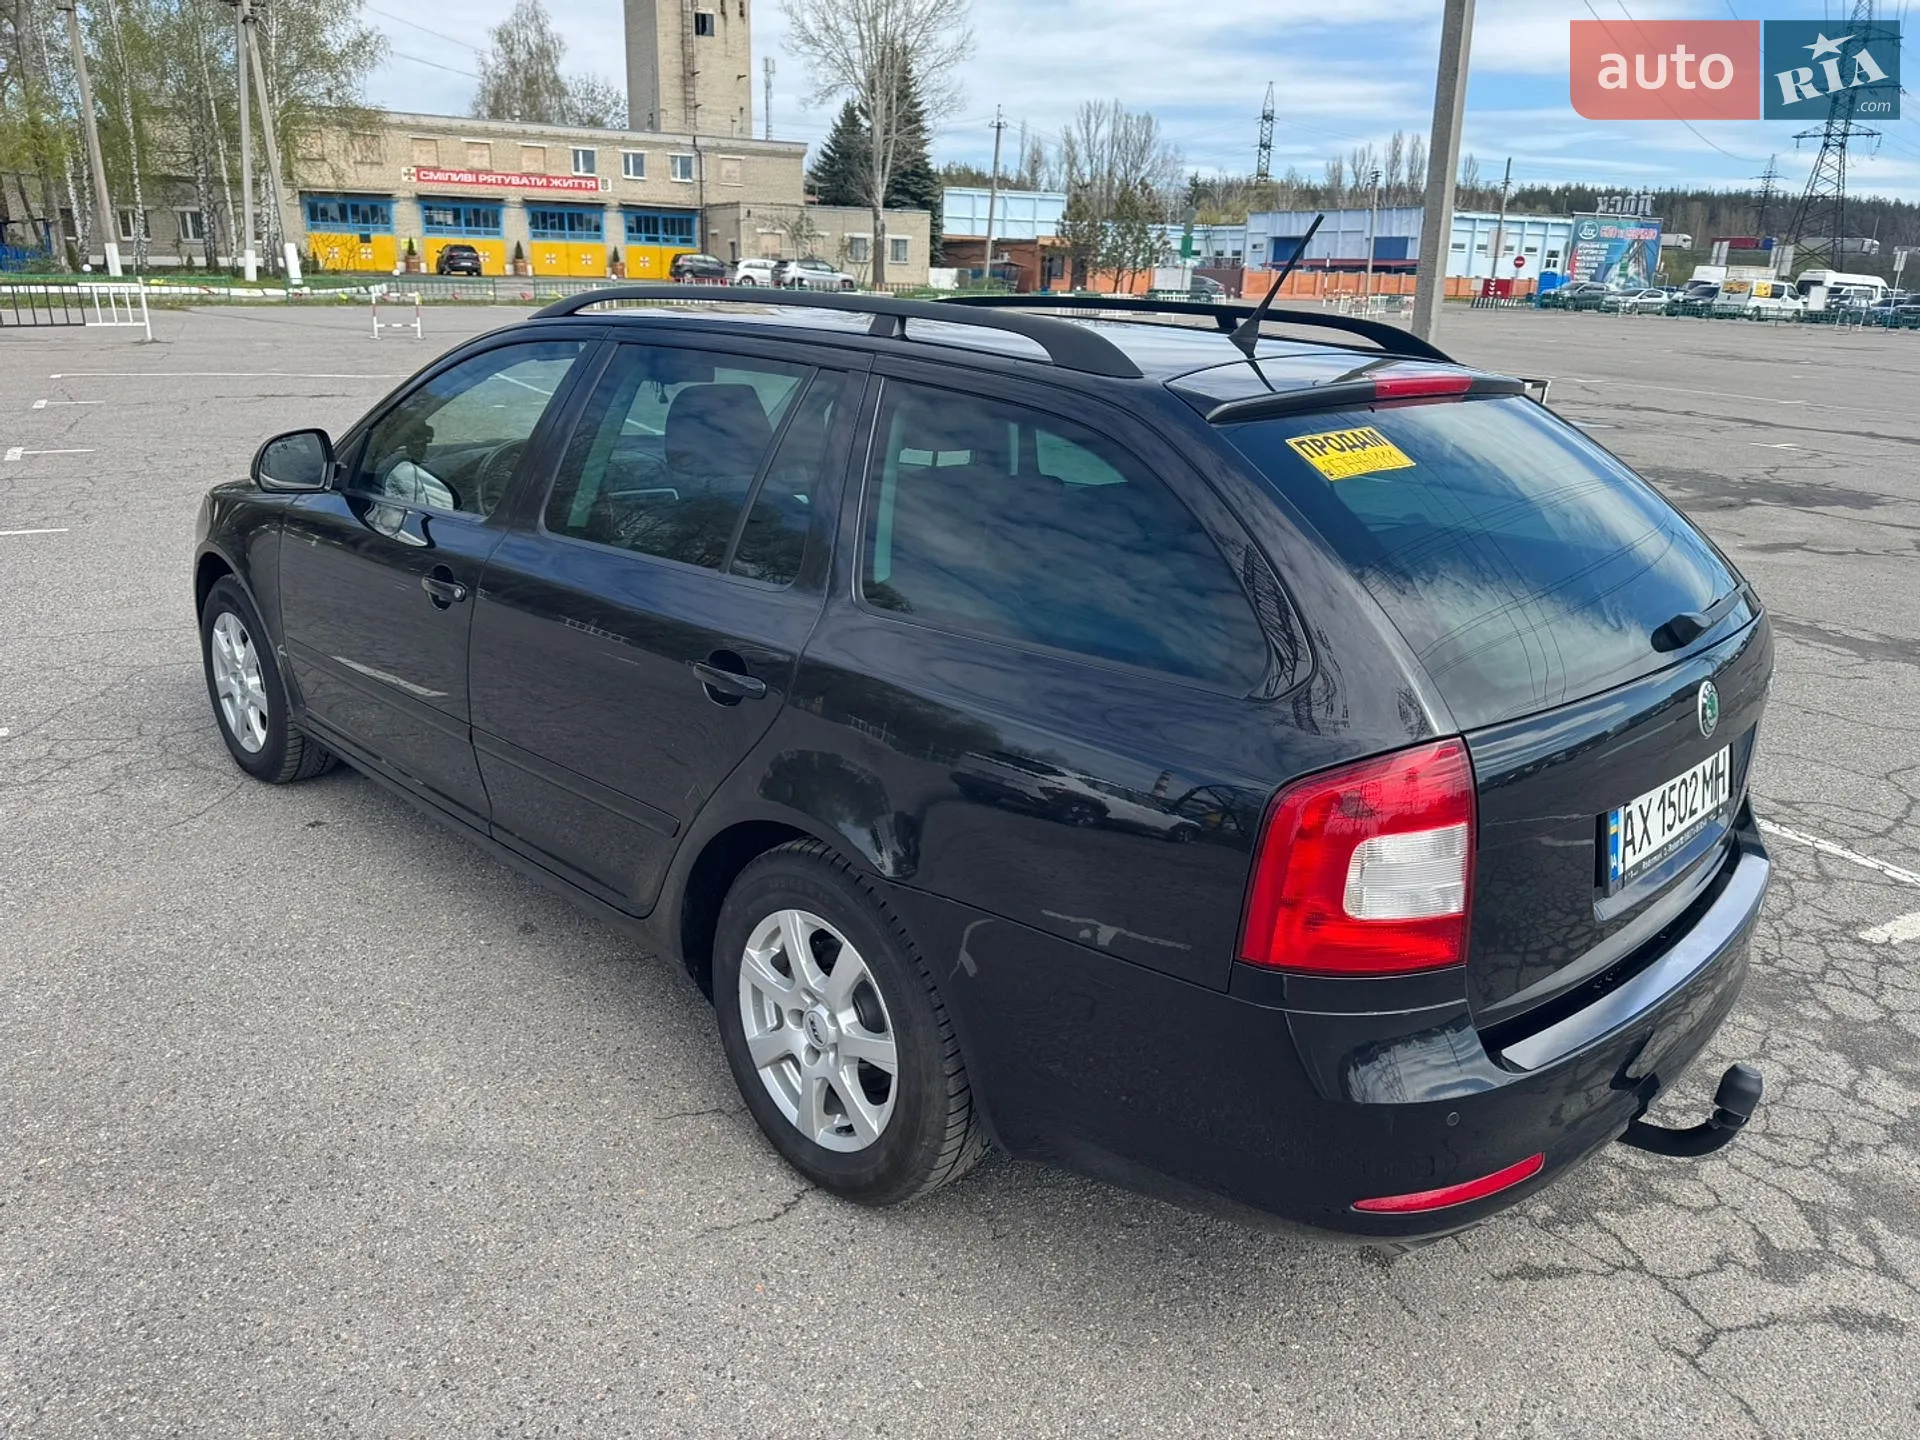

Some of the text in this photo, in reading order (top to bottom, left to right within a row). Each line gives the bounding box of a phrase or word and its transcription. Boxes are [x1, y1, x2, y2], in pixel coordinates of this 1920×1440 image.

[419, 170, 597, 190] СМІЛИВІ РЯТУВАТИ ЖИТТЯ
[1294, 430, 1389, 458] ПРОДАМ
[1622, 797, 1652, 863] AX
[1657, 771, 1699, 837] 1502
[1702, 751, 1727, 810] MH
